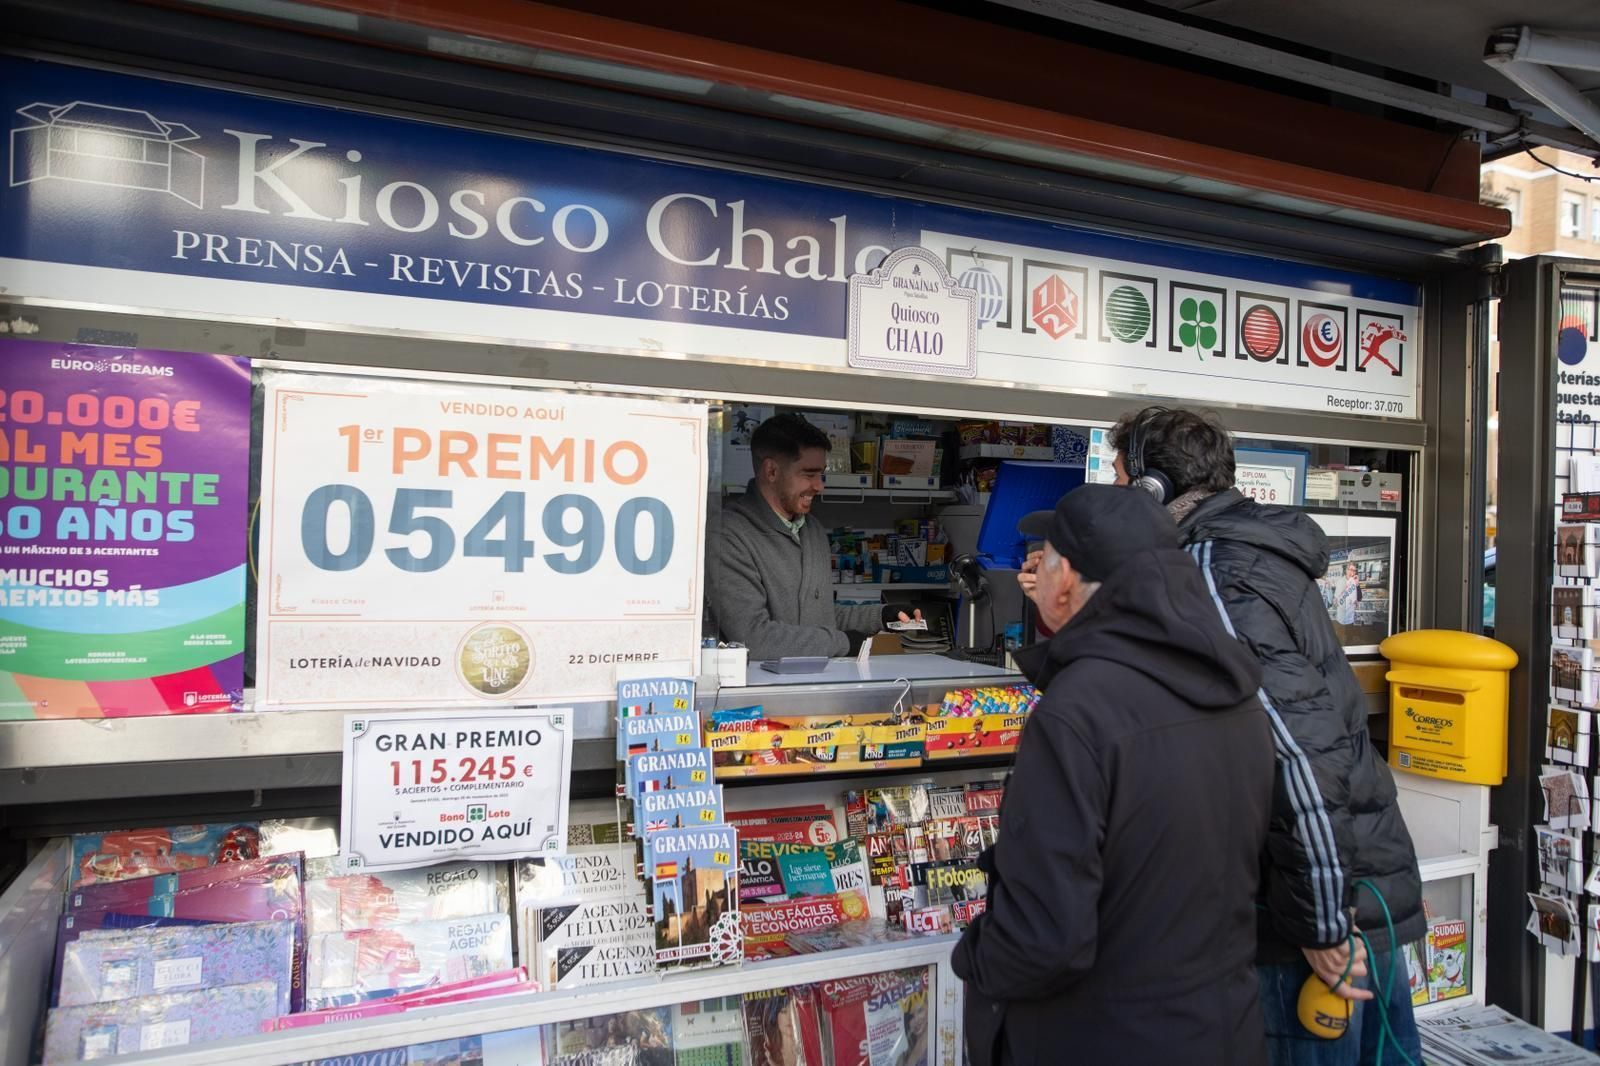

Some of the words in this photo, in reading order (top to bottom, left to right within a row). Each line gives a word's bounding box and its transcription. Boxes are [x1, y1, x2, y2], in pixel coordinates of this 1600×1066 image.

[221, 128, 609, 254] Kiosco
[172, 229, 356, 277] PRENSA
[389, 254, 583, 299] REVISTAS
[614, 278, 790, 321] LOTERÍAS
[891, 302, 940, 325] Quiosco
[886, 327, 944, 356] CHALO
[51, 358, 95, 371] EURO
[111, 363, 174, 377] DREAMS
[0, 390, 201, 432] 0.000€
[440, 401, 518, 419] VENDIDO
[524, 405, 566, 422] AQUÍ
[1326, 394, 1373, 412] Receptor:
[1374, 400, 1403, 414] 37.070
[60, 431, 163, 467] MES
[391, 426, 649, 486] PREMIO
[0, 505, 41, 539] 0
[56, 498, 195, 541] AÑOS
[300, 483, 676, 576] 05490
[4, 545, 20, 554] UN
[22, 544, 67, 555] MÁXIMO
[69, 547, 84, 555] DE
[85, 547, 92, 555] 3
[94, 547, 159, 556] ACERTANTES
[105, 585, 160, 607] MÁS
[569, 654, 584, 665] 22
[622, 681, 688, 699] GRANADA
[628, 715, 694, 736] GRANADA
[1413, 713, 1454, 727] CORREOS
[376, 732, 447, 752] GRAN
[456, 729, 542, 749] PREMIO
[637, 752, 707, 773] GRANADA
[864, 751, 884, 760] KIND
[390, 755, 516, 786] 115.245
[523, 764, 534, 778] €
[395, 787, 401, 796] 5
[402, 785, 441, 795] ACIERTOS
[450, 781, 525, 792] COMPLEMENTARIO
[645, 789, 717, 812] GRANADA
[941, 804, 962, 816] VIDA
[439, 813, 465, 822] Bono
[488, 809, 511, 818] Loto
[379, 827, 474, 849] VENDIDO
[482, 818, 532, 841] AQUÍ
[655, 832, 730, 854] GRANADA
[426, 868, 479, 885] REGALO
[788, 870, 828, 883] hermanas
[804, 863, 822, 873] siete
[581, 901, 639, 920] AGENDA
[743, 907, 785, 923] MENÚS
[785, 903, 835, 919] FÁCILES
[448, 920, 501, 939] REGALO
[564, 918, 619, 938] TELVA
[752, 914, 839, 934] ECONÓMICOS
[1435, 923, 1465, 937] SUDOKU
[597, 945, 656, 961] AGENDA
[578, 960, 632, 979] TELVA
